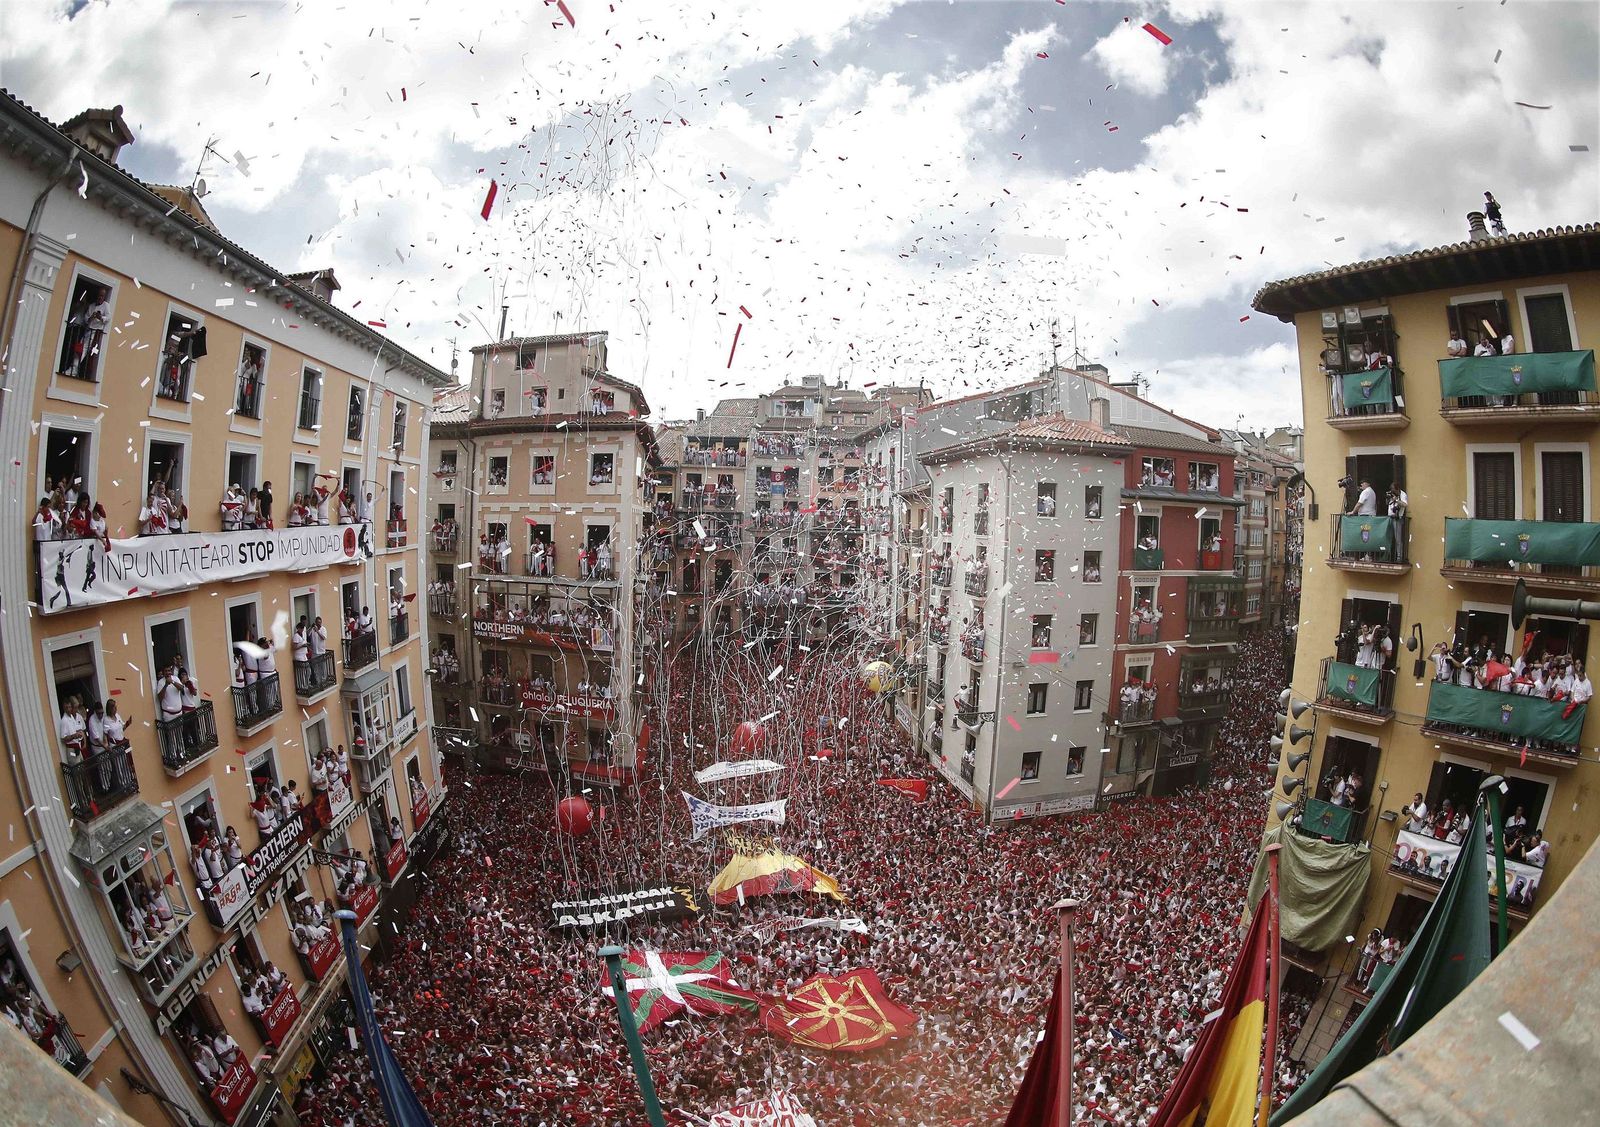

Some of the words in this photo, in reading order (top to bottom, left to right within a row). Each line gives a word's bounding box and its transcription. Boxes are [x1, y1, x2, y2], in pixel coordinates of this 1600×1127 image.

[101, 544, 234, 583] INPUNITATEARI
[239, 540, 274, 565] STOP
[474, 621, 524, 635] NORTHERN
[1102, 791, 1136, 802] GUTIERREZ
[244, 815, 304, 882] NORTHERN
[248, 869, 268, 892] SPAIN
[267, 841, 299, 875] TRAVEL.com
[156, 944, 231, 1036] AGENCIA
[322, 778, 393, 851] INMOBILIARIA
[274, 992, 293, 1018] EROSKI
[226, 1064, 246, 1093] EROKI
